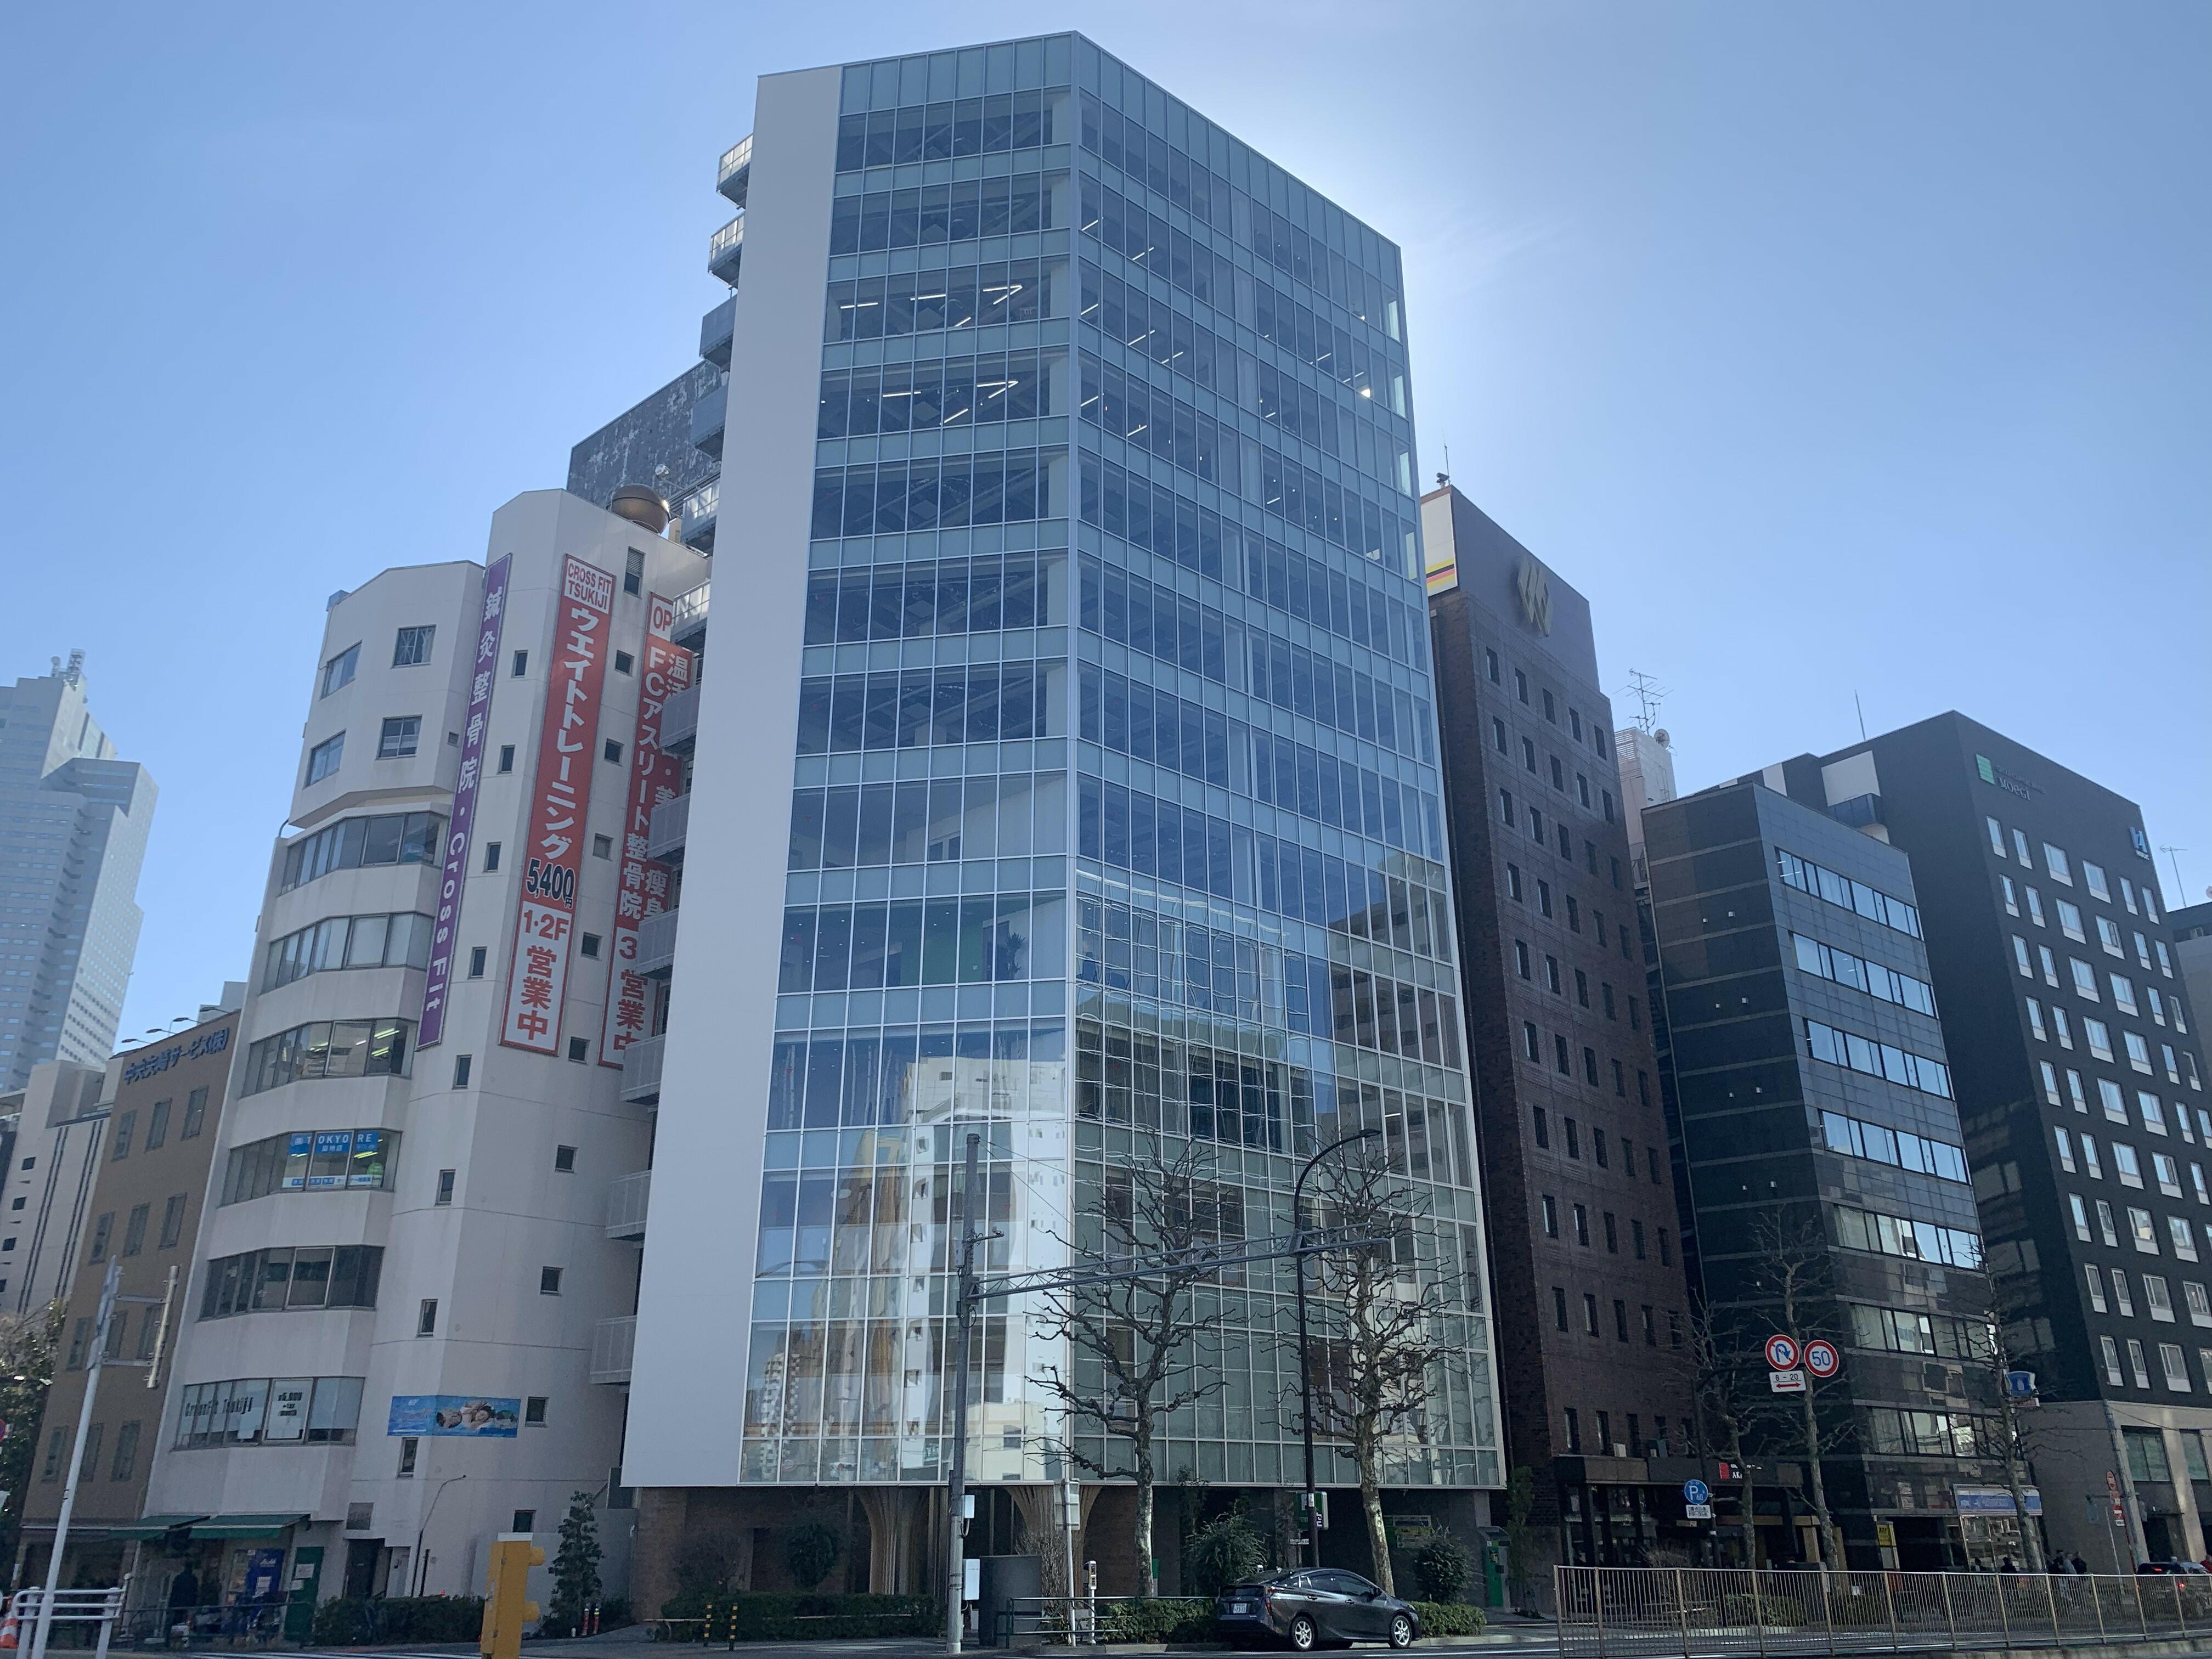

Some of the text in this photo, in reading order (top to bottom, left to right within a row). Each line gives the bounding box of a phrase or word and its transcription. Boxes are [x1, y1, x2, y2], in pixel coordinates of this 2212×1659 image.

[568, 563, 612, 594] CROSS FIT
[568, 579, 607, 610] TSUKIJI
[517, 945, 557, 1041] 営業中
[1812, 1350, 1831, 1367] 50
[1689, 1485, 1699, 1501] P
